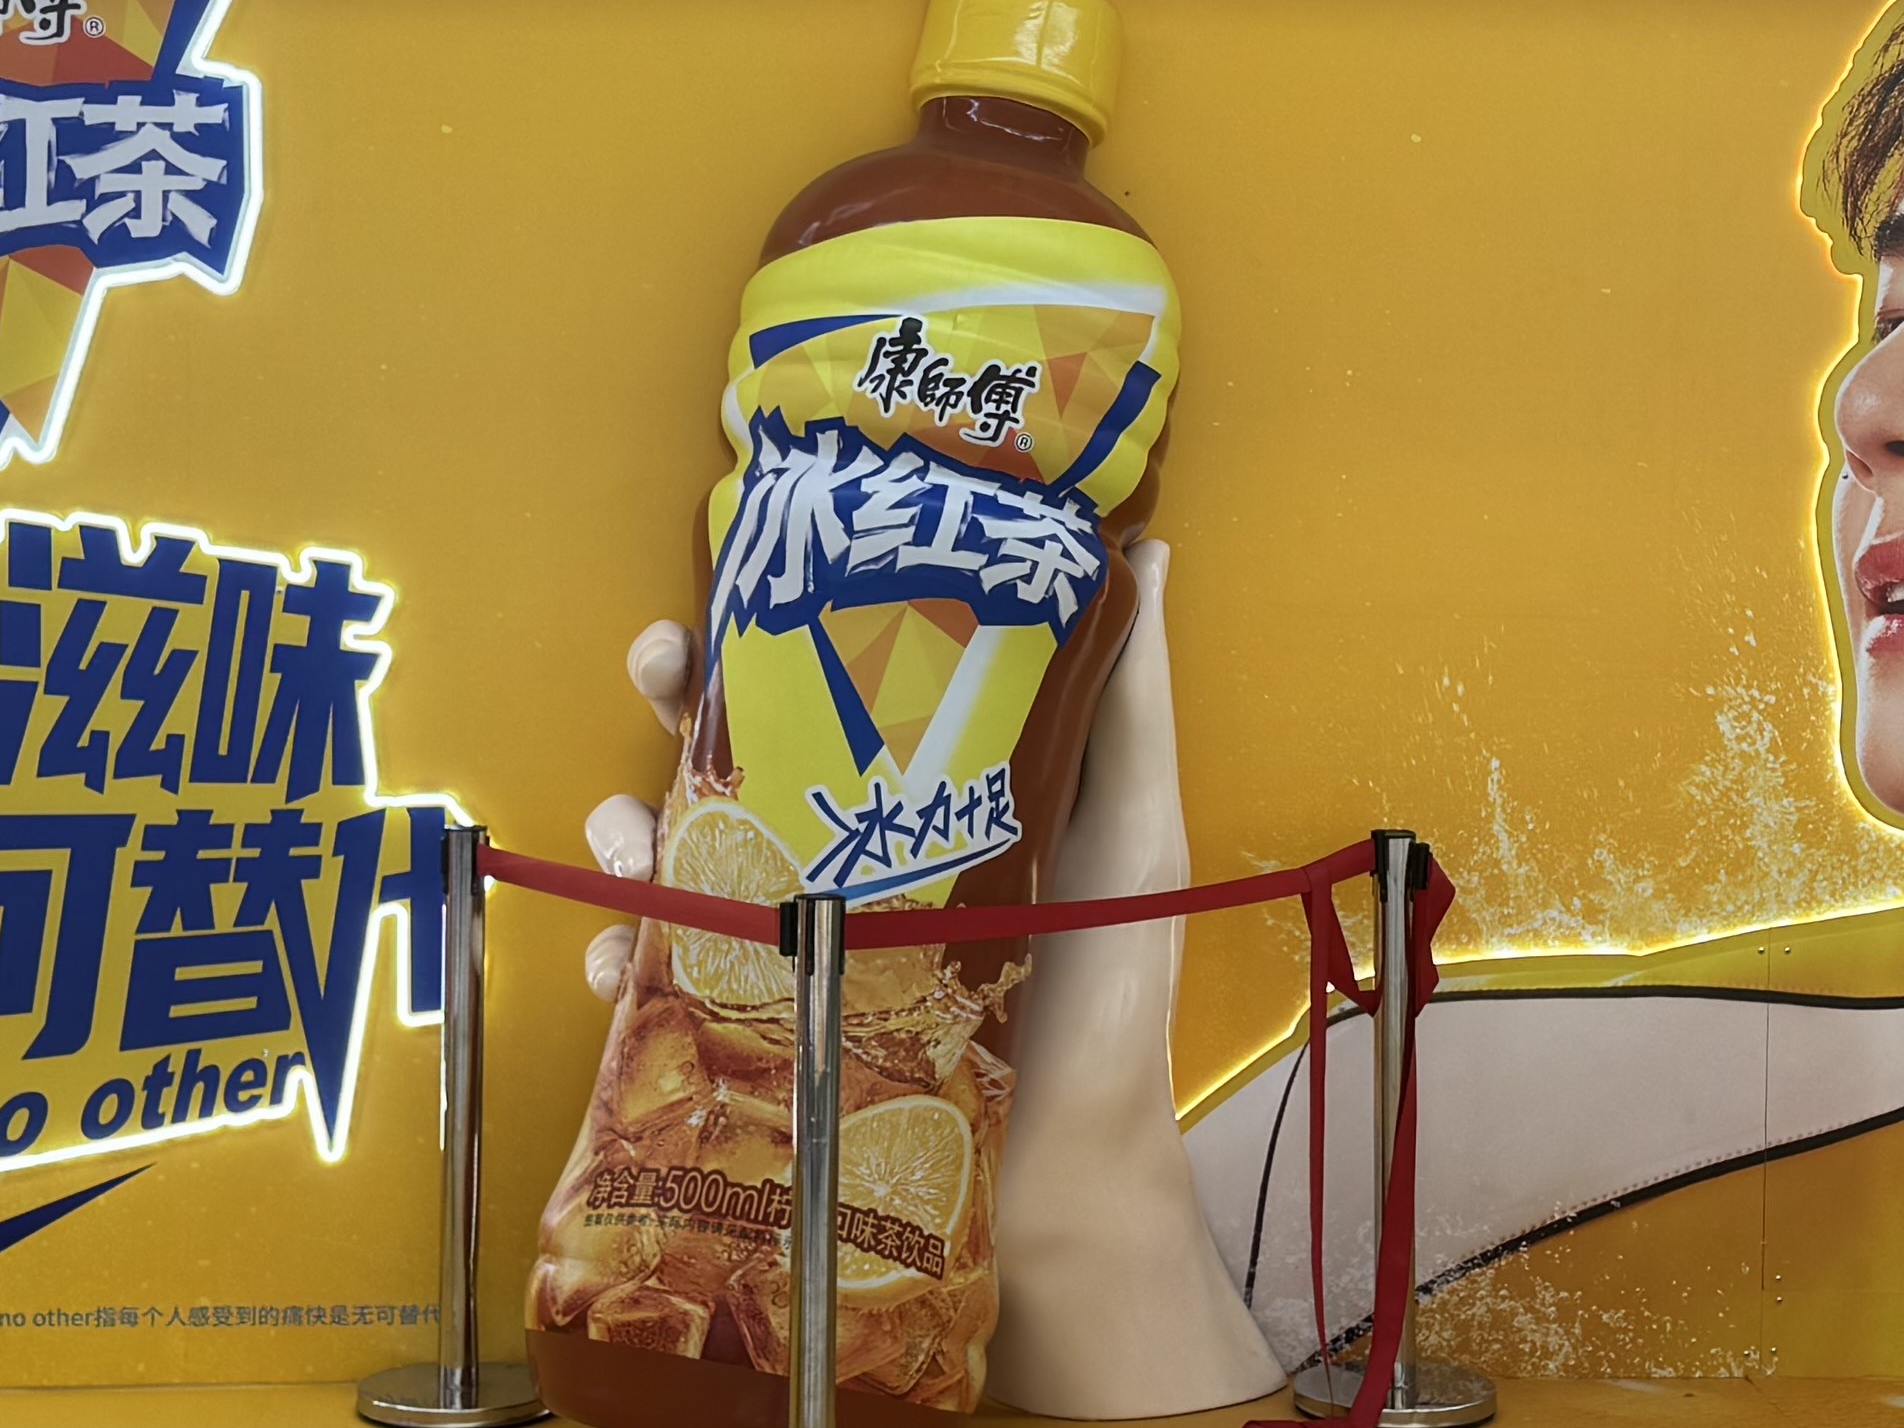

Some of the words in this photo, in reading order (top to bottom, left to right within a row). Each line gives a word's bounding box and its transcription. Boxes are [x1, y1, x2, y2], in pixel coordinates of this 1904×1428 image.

[710, 430, 1100, 641] 冰红茶
[80, 1046, 306, 1139] other
